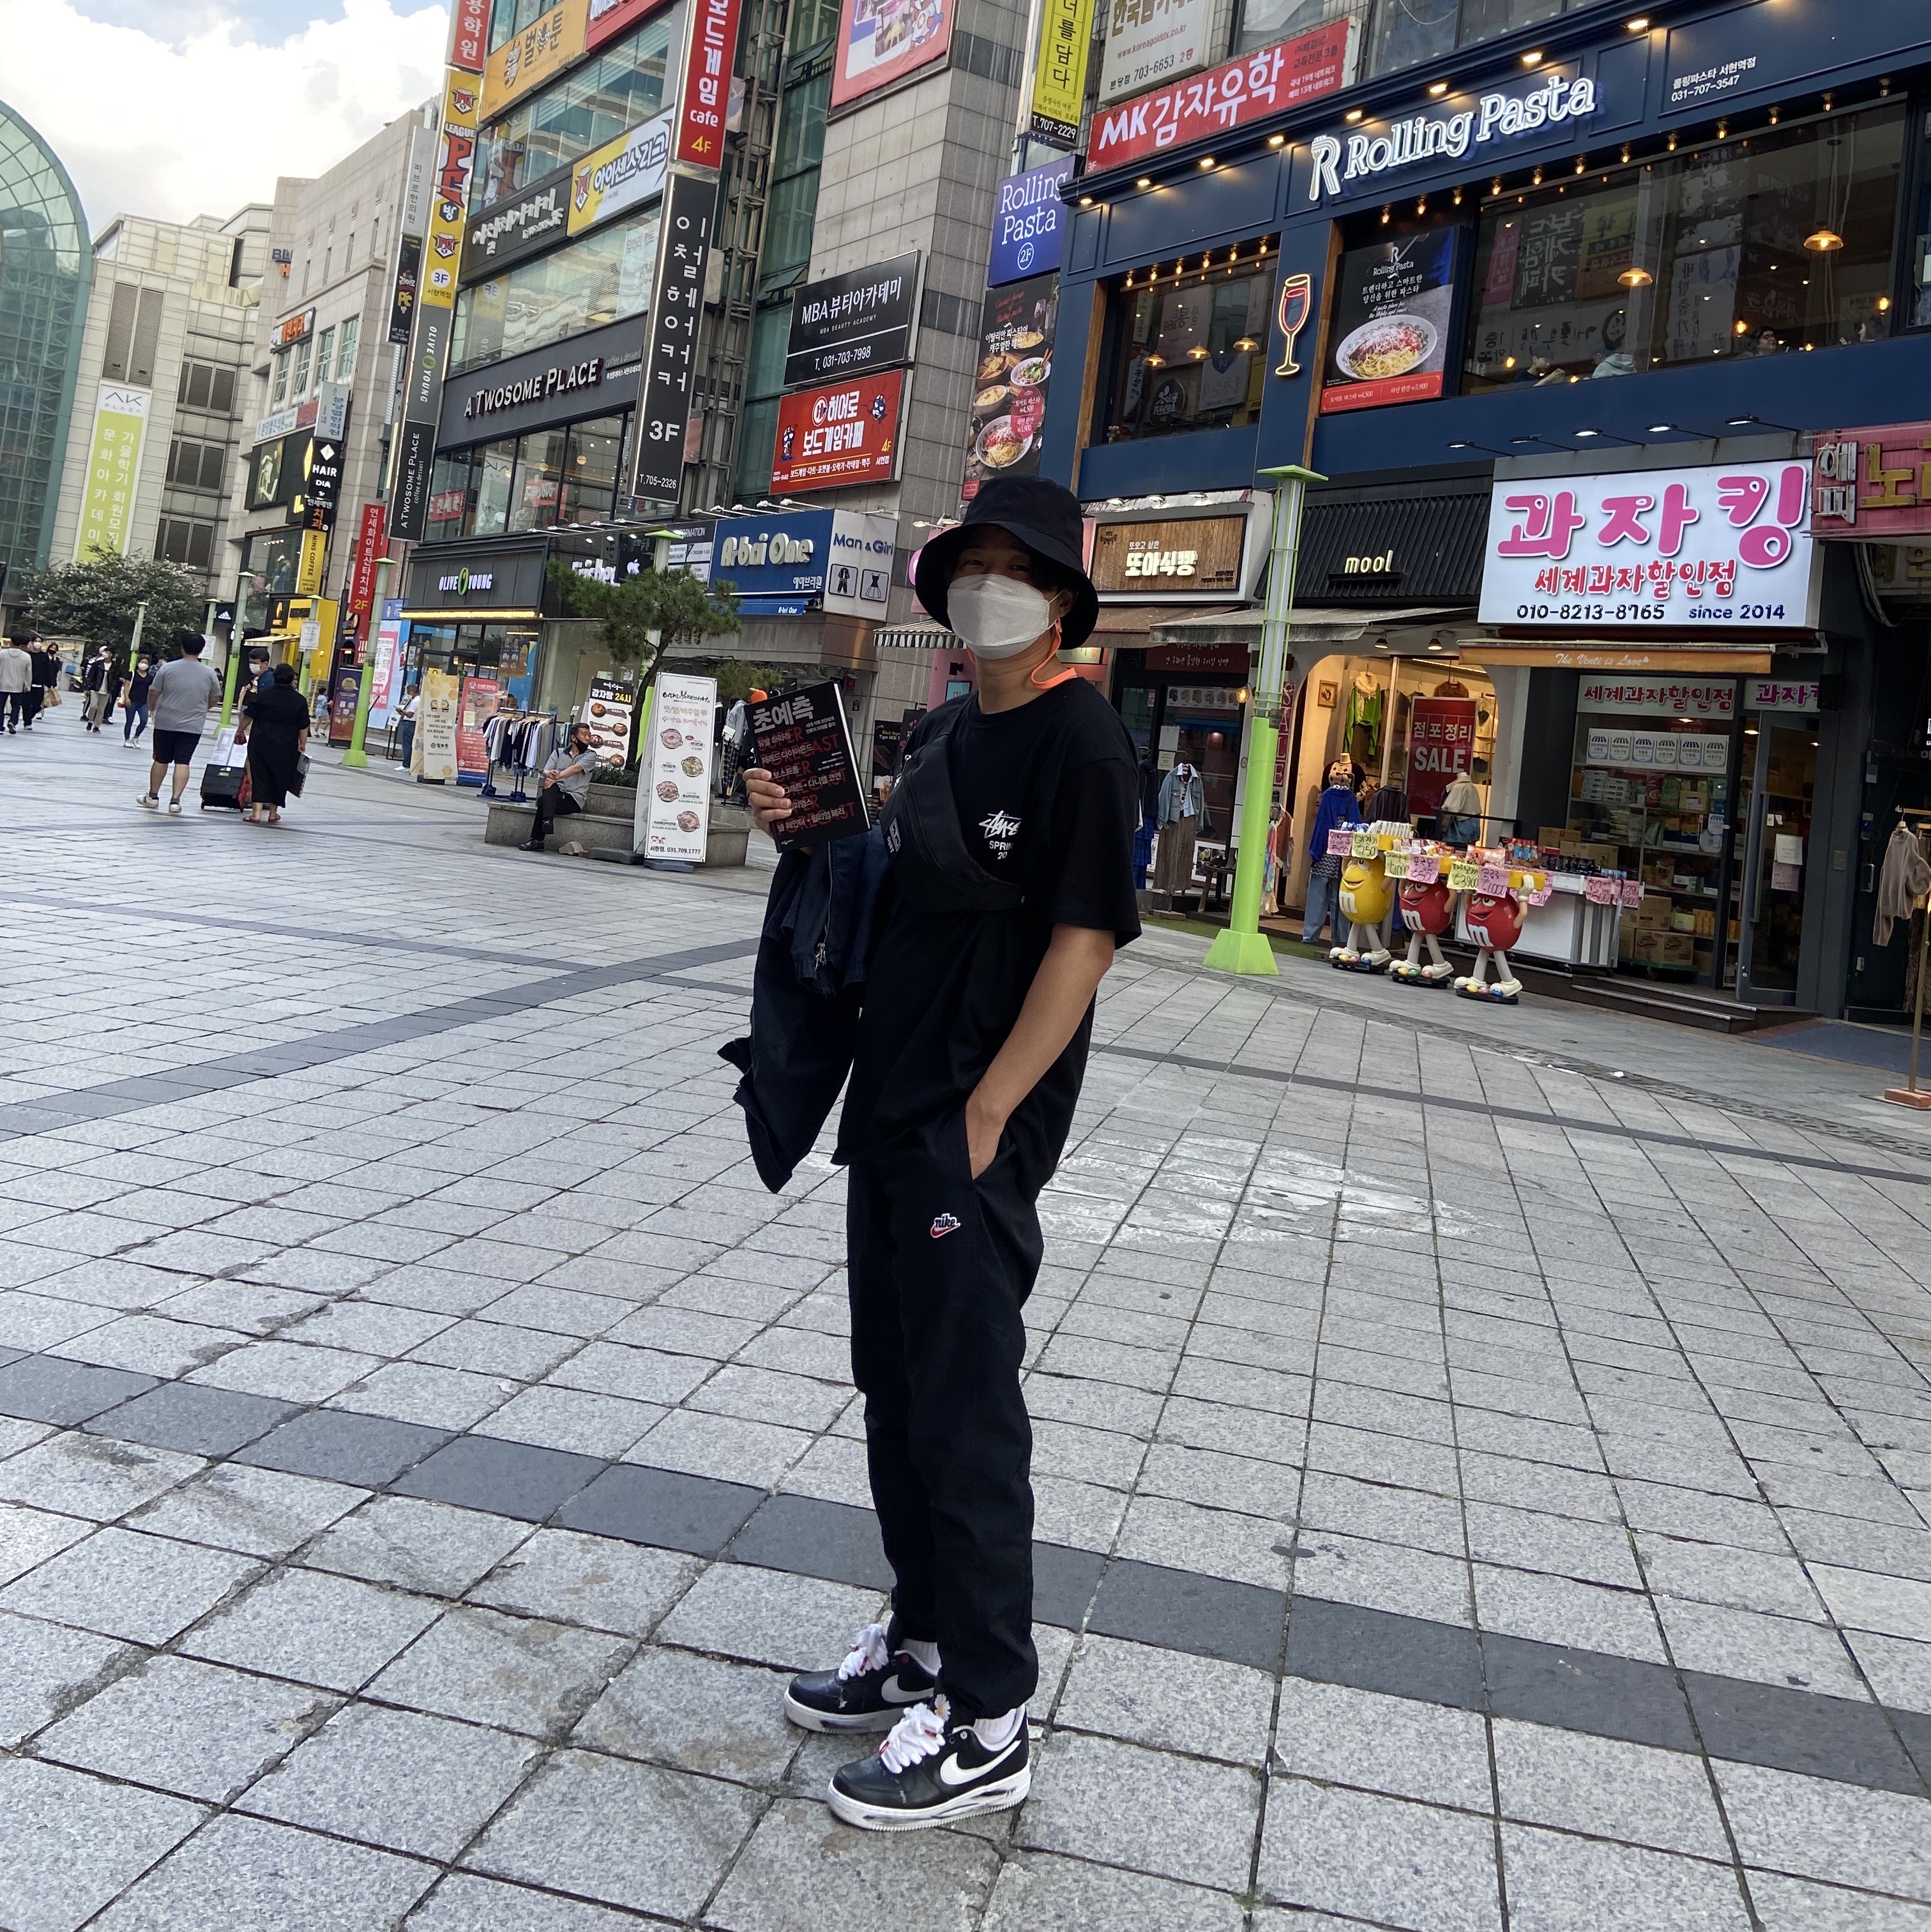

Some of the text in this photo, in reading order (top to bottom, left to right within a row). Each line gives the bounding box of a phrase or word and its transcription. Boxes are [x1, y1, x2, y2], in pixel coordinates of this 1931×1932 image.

[1110, 48, 1193, 91] 분당점 703-6653 2층
[1302, 72, 1314, 83] 19개
[1314, 65, 1336, 79] 네트워크
[1672, 56, 1757, 90] 롤링파스타 서현역점
[1301, 84, 1312, 94] 13개
[1313, 77, 1335, 90] 네트워크
[1670, 75, 1741, 103] 031-707-3547
[690, 109, 719, 127] cafe
[1032, 115, 1077, 139] T.707-2229
[1344, 75, 1599, 181] Rolling Pasta
[444, 123, 476, 138] LEAGUE
[690, 135, 712, 153] 4F
[594, 131, 669, 194] 아이센스리그
[1087, 161, 1096, 172] 3F
[408, 164, 422, 224] 피브로한의원
[443, 204, 457, 221] 방
[1001, 206, 1057, 245] Pasta
[1020, 247, 1032, 264] 2F
[434, 271, 449, 284] 3F
[1373, 261, 1414, 277] Rolling Pasta
[427, 288, 453, 300] 서현역점
[1361, 274, 1423, 294] 트렌디하고 스마트한
[1363, 284, 1420, 304] 당신을 위한 파스타
[657, 216, 707, 392] 이철헤어커커
[831, 321, 851, 332] BEAUTY
[852, 314, 877, 328] ACADEMY
[425, 325, 439, 355] OLIVE
[605, 354, 619, 369] coffee
[815, 346, 872, 371] T. 031-703-7998
[419, 371, 431, 404] YOUNG
[464, 357, 600, 418] A TWOSOME PLACE
[104, 403, 142, 413] PLAZA
[105, 392, 143, 407] AK
[828, 390, 861, 422] 히어로
[649, 420, 680, 443] 3F
[801, 420, 865, 457] 보드게임카페
[881, 437, 891, 453] 4F
[115, 431, 135, 485] 가을학기
[875, 455, 890, 466] 서현점
[312, 464, 337, 477] HAIR
[402, 431, 421, 517] TWOSOME PLACE
[415, 459, 425, 480] dessert
[87, 429, 116, 542] 문화아카데미
[315, 480, 331, 488] DIA
[639, 473, 677, 490] T.705-2326
[1496, 465, 1807, 569] 과자킹
[768, 532, 814, 565] One
[833, 533, 895, 556] Man & Girl
[1128, 540, 1160, 550] 또오고 싶은
[307, 552, 315, 577] COFFEE
[1125, 550, 1199, 577] 또아식빵
[1344, 549, 1394, 574] mool
[439, 574, 493, 591] OLIVE YOUNG
[792, 576, 822, 589] 에이브리원
[1533, 558, 1737, 602] 세계과자할인점
[354, 599, 368, 610] 2F
[1516, 604, 1785, 621] 010-8213-8765 since 2014
[1555, 652, 1573, 666] The
[1604, 655, 1614, 666] is
[1617, 655, 1643, 667] Love
[591, 688, 632, 703] 감자탕 24시
[1584, 684, 1734, 712] 세계과자할인점
[753, 695, 814, 734] 초예측
[757, 731, 792, 749] 유발 하라리
[1413, 720, 1473, 743] 점포정리
[781, 743, 815, 759] 다이아몬드
[1414, 746, 1465, 773] SALE
[807, 774, 828, 788] 다니엘
[828, 771, 842, 782] 코엔
[785, 807, 845, 830] 페인터 윌리엄 페리
[934, 1215, 956, 1228] nike
